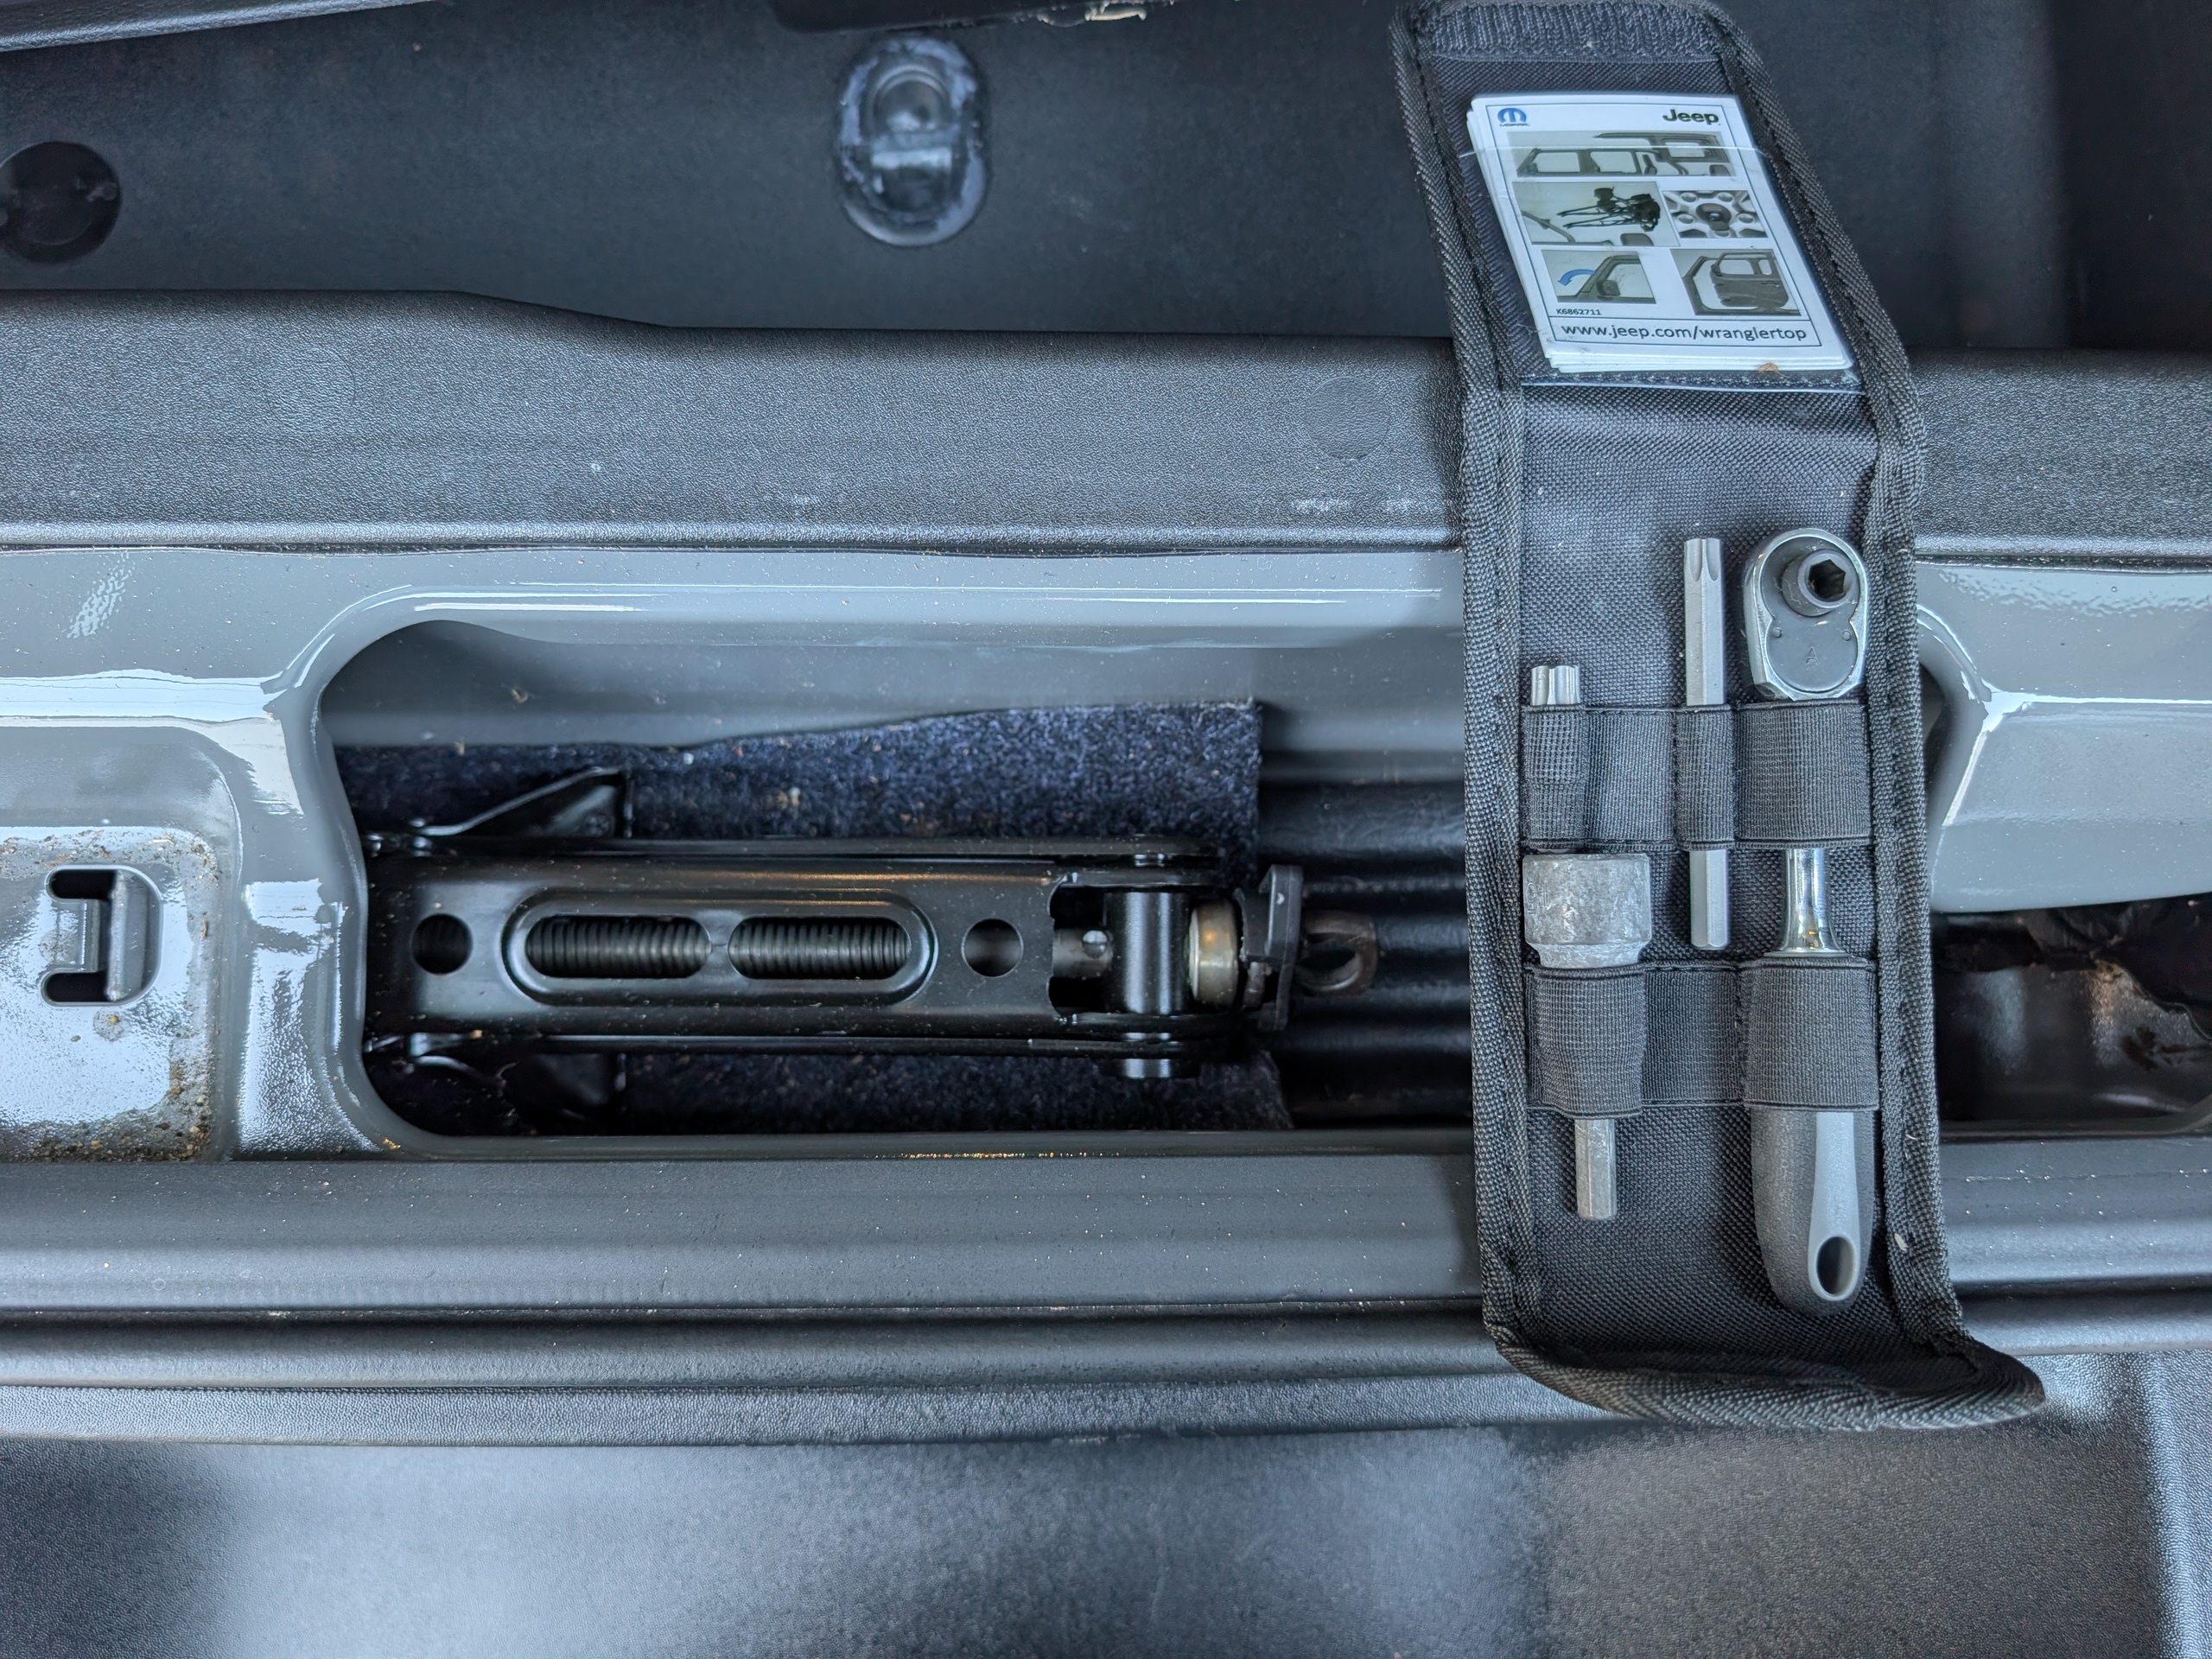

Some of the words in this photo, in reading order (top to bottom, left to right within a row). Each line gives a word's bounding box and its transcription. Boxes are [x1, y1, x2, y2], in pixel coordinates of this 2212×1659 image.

[1662, 109, 1719, 125] Jeep
[1555, 308, 1602, 316] K6862711
[1560, 324, 1807, 341] www.jeep.com/wranglertop
[1805, 646, 1819, 664] A
